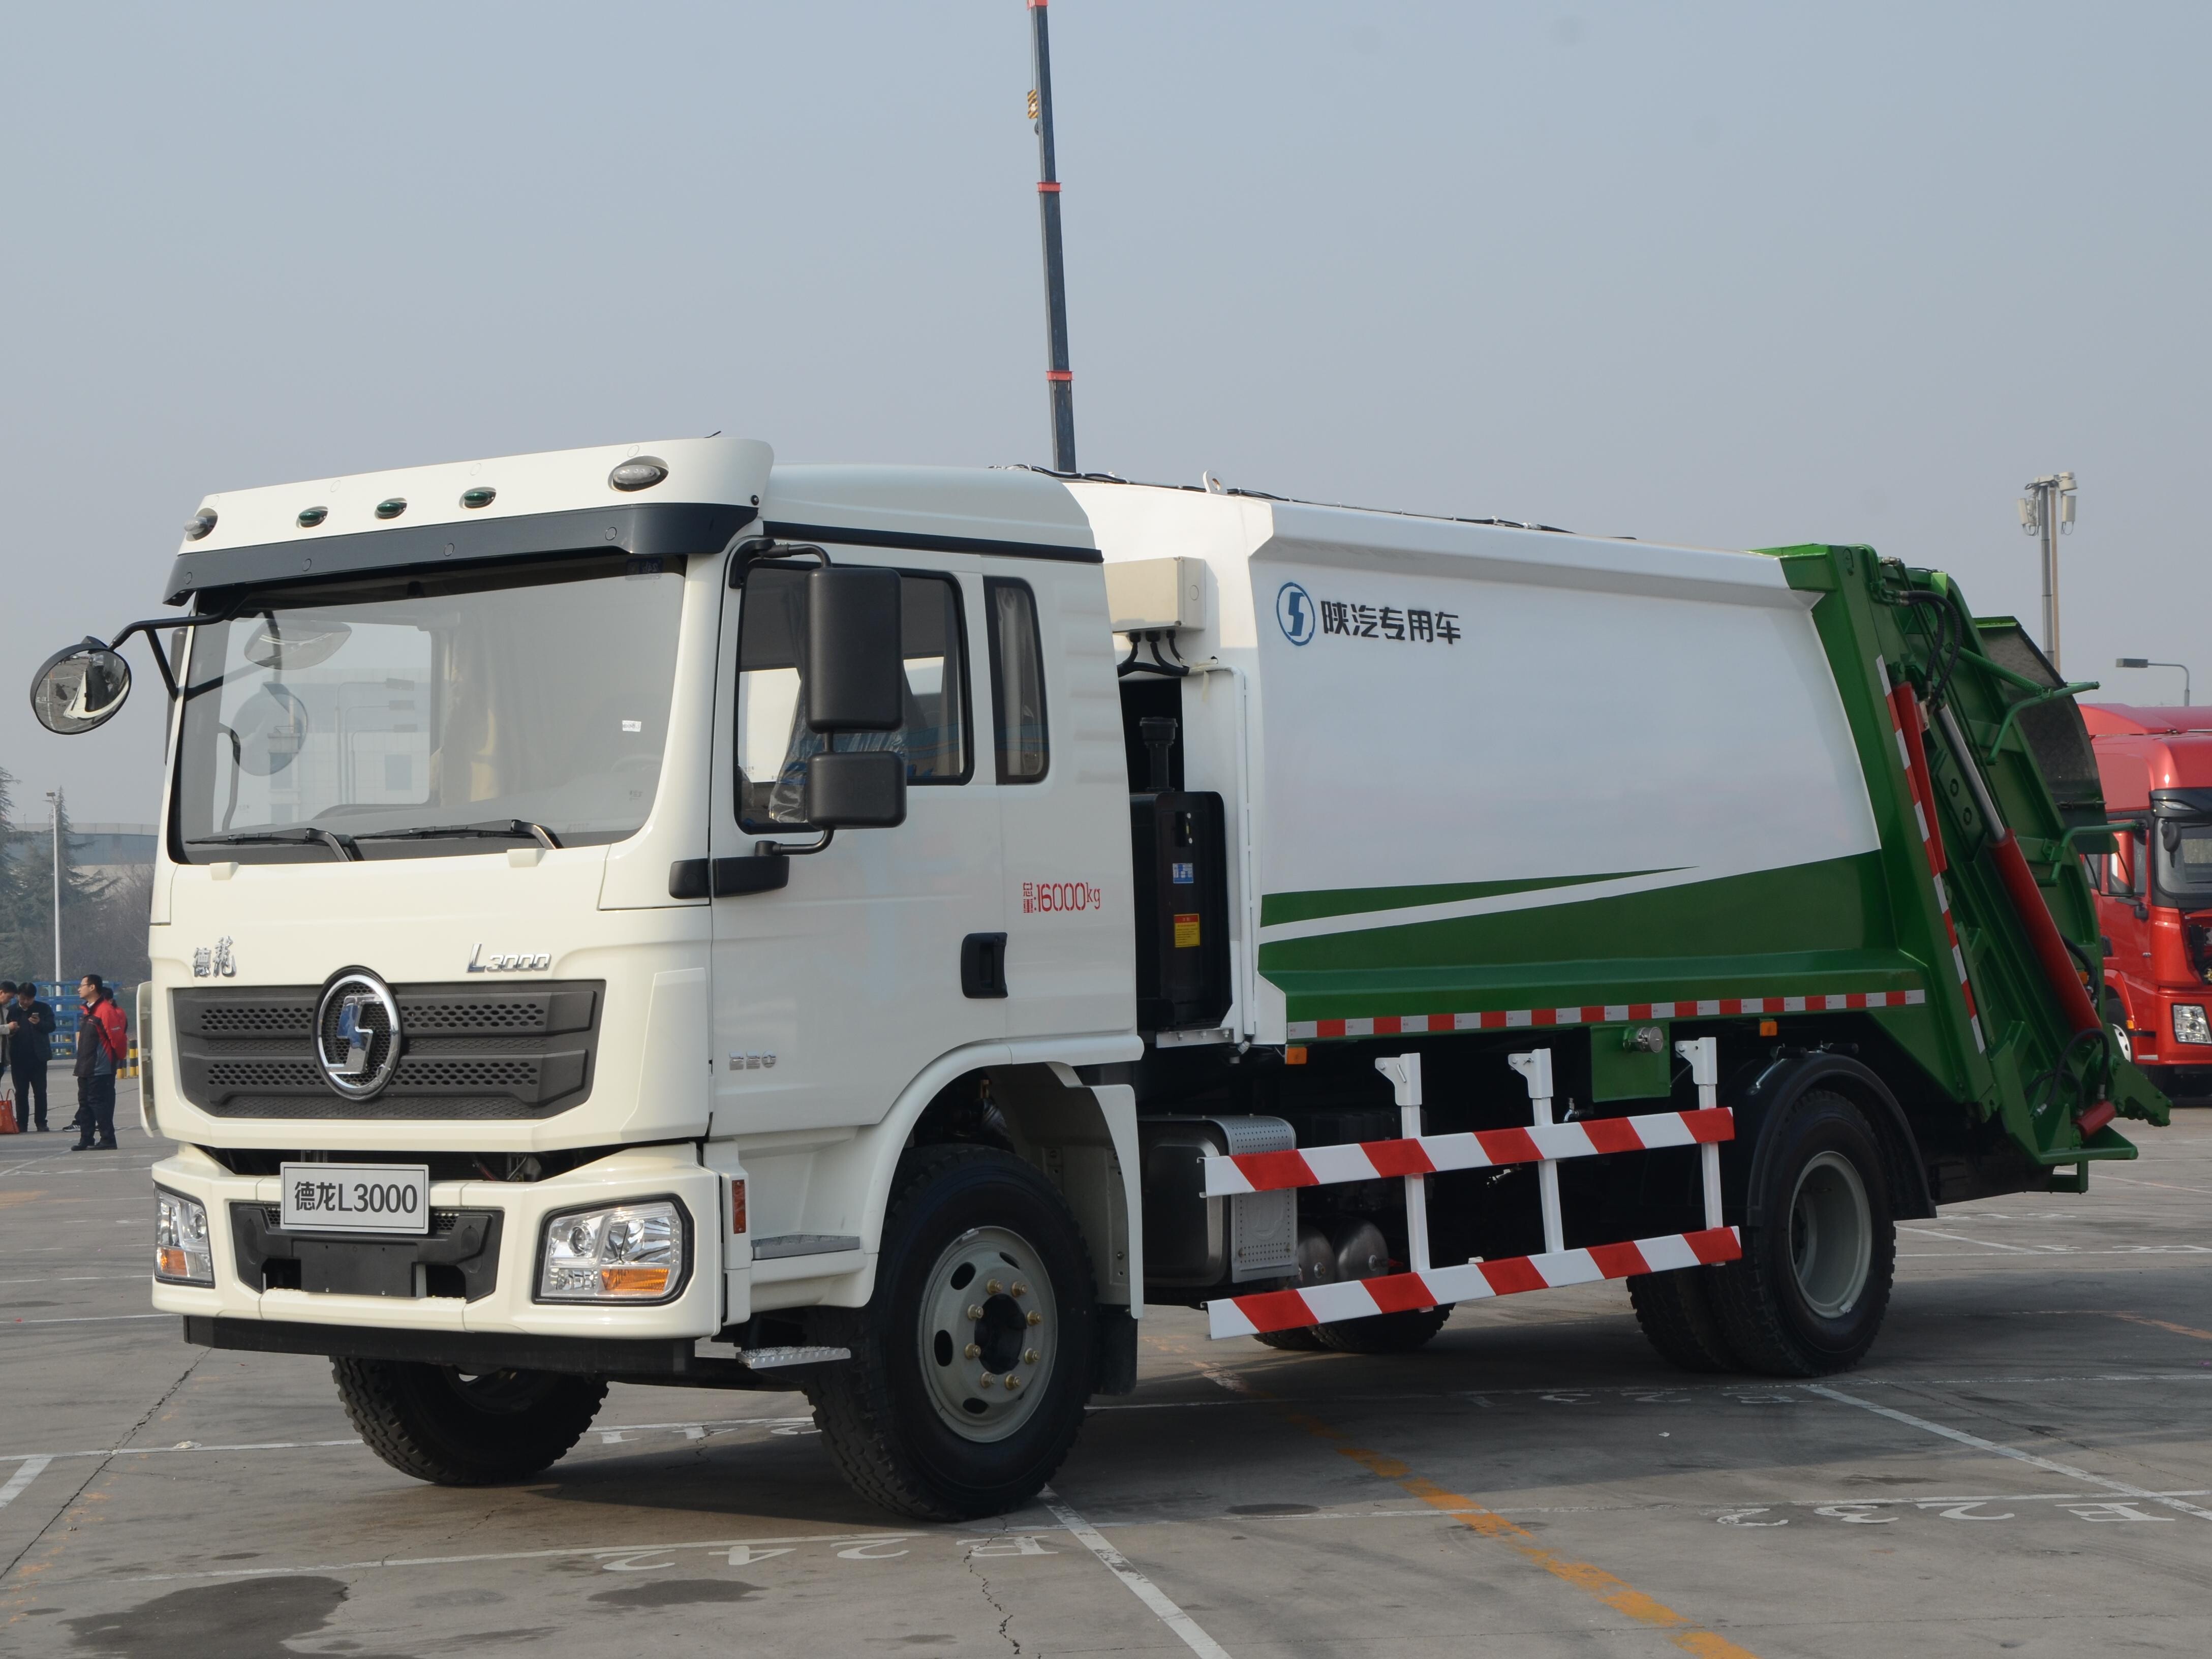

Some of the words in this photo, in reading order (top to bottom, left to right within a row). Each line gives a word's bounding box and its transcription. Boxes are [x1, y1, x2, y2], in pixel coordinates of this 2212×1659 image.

[1320, 601, 1461, 644] 陕汽专用车
[466, 943, 552, 973] L3000
[294, 1181, 418, 1214] 德龙L3000
[594, 1535, 1058, 1571] E242
